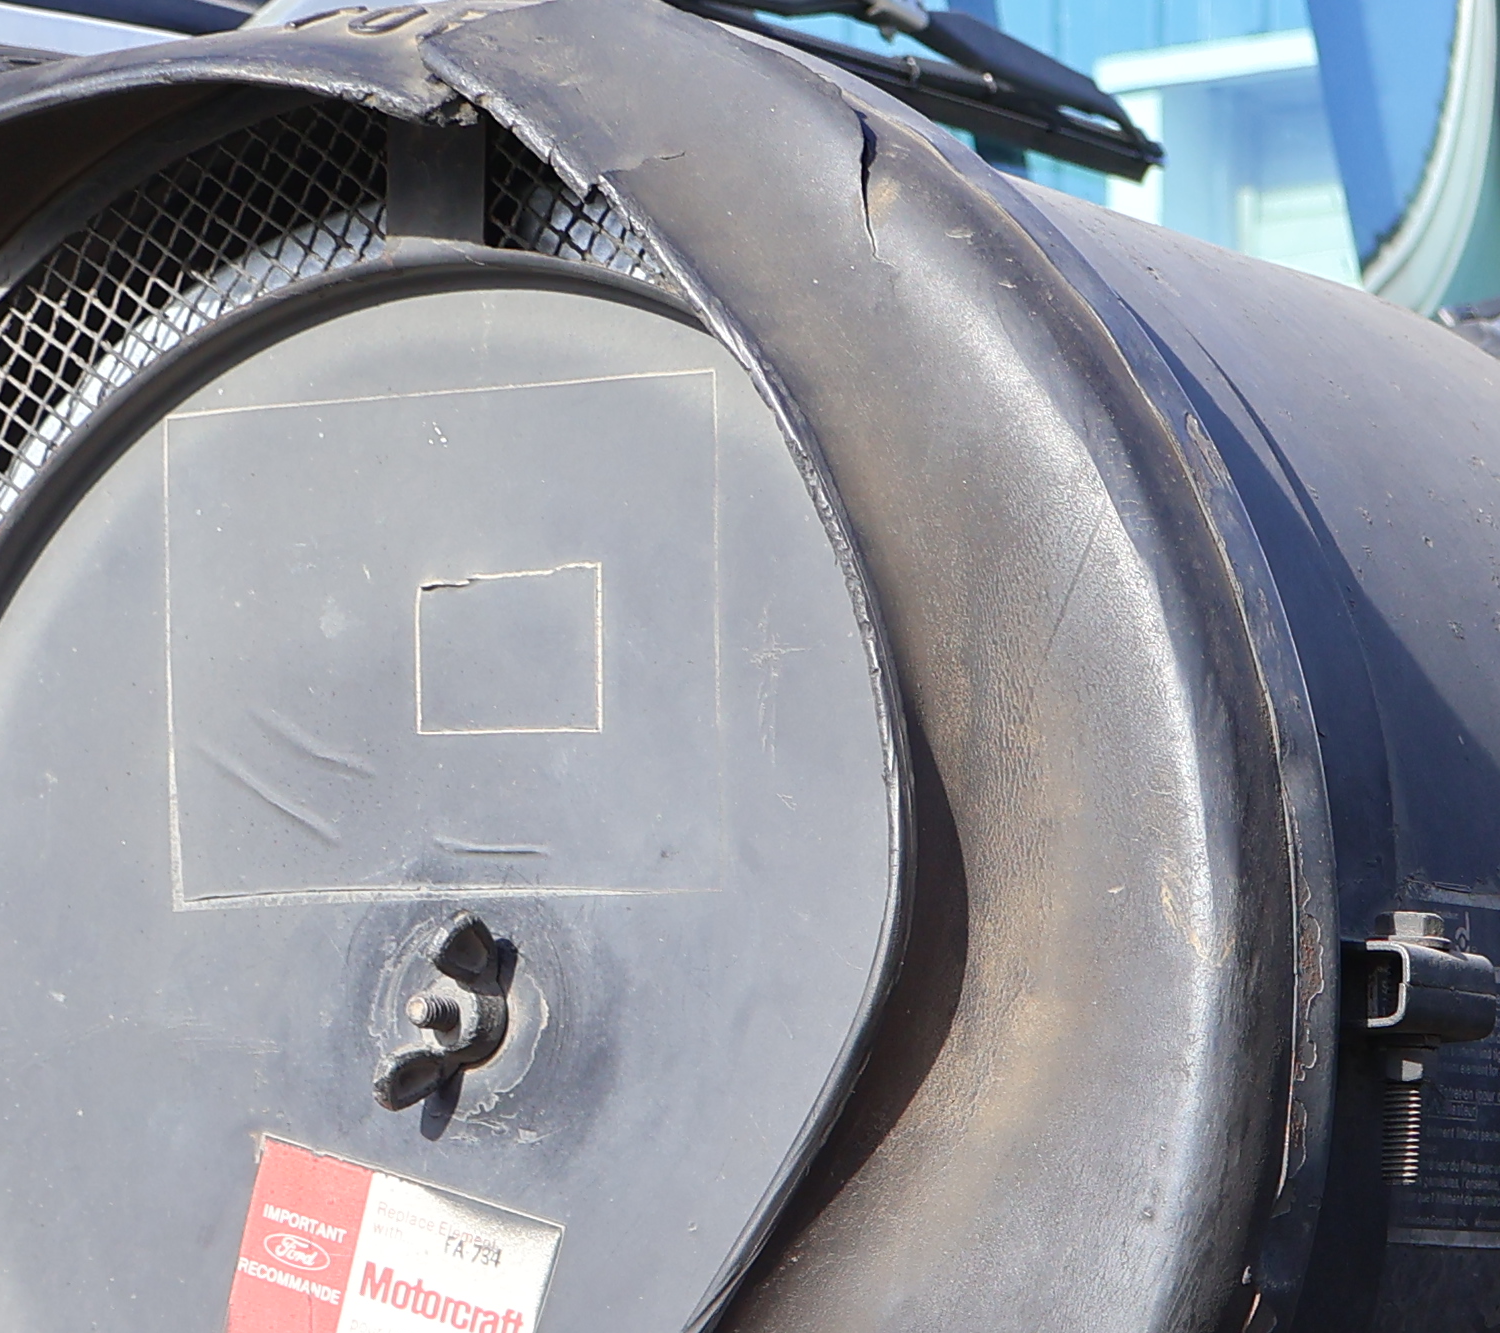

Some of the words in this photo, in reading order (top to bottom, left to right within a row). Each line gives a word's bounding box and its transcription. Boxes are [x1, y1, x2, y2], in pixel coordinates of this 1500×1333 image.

[262, 1203, 348, 1244] IMPORTANT
[377, 1201, 436, 1233] Replace
[274, 1236, 318, 1266] Ford
[237, 1256, 341, 1306] RECOMMANDE
